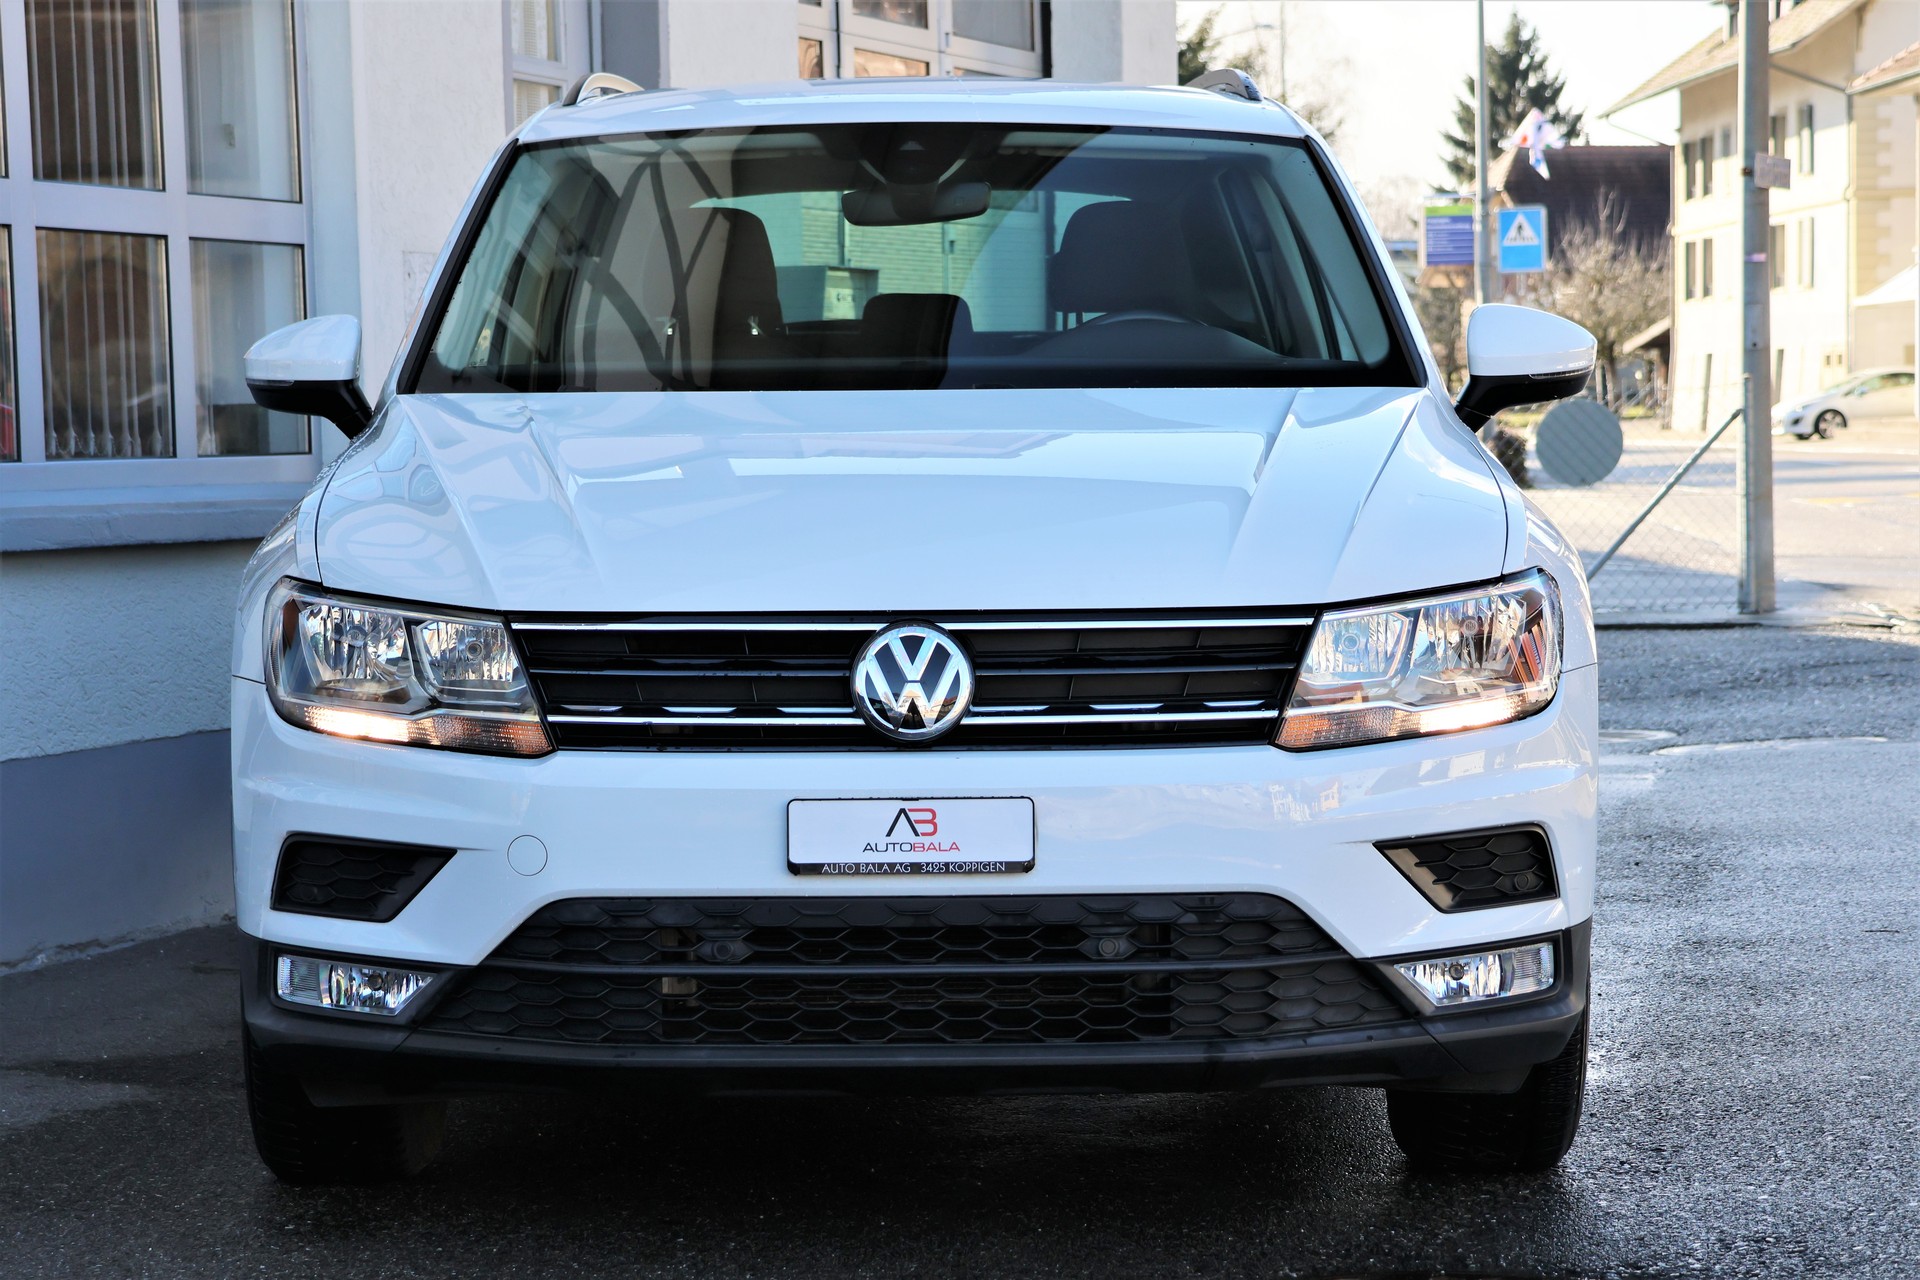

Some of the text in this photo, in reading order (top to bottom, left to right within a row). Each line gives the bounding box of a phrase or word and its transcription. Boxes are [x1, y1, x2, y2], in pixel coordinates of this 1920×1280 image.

[885, 807, 938, 837] AB
[862, 841, 961, 853] AUTOBALA
[821, 861, 1006, 874] AUTO BALA AG 3425 KOPPIGEN
